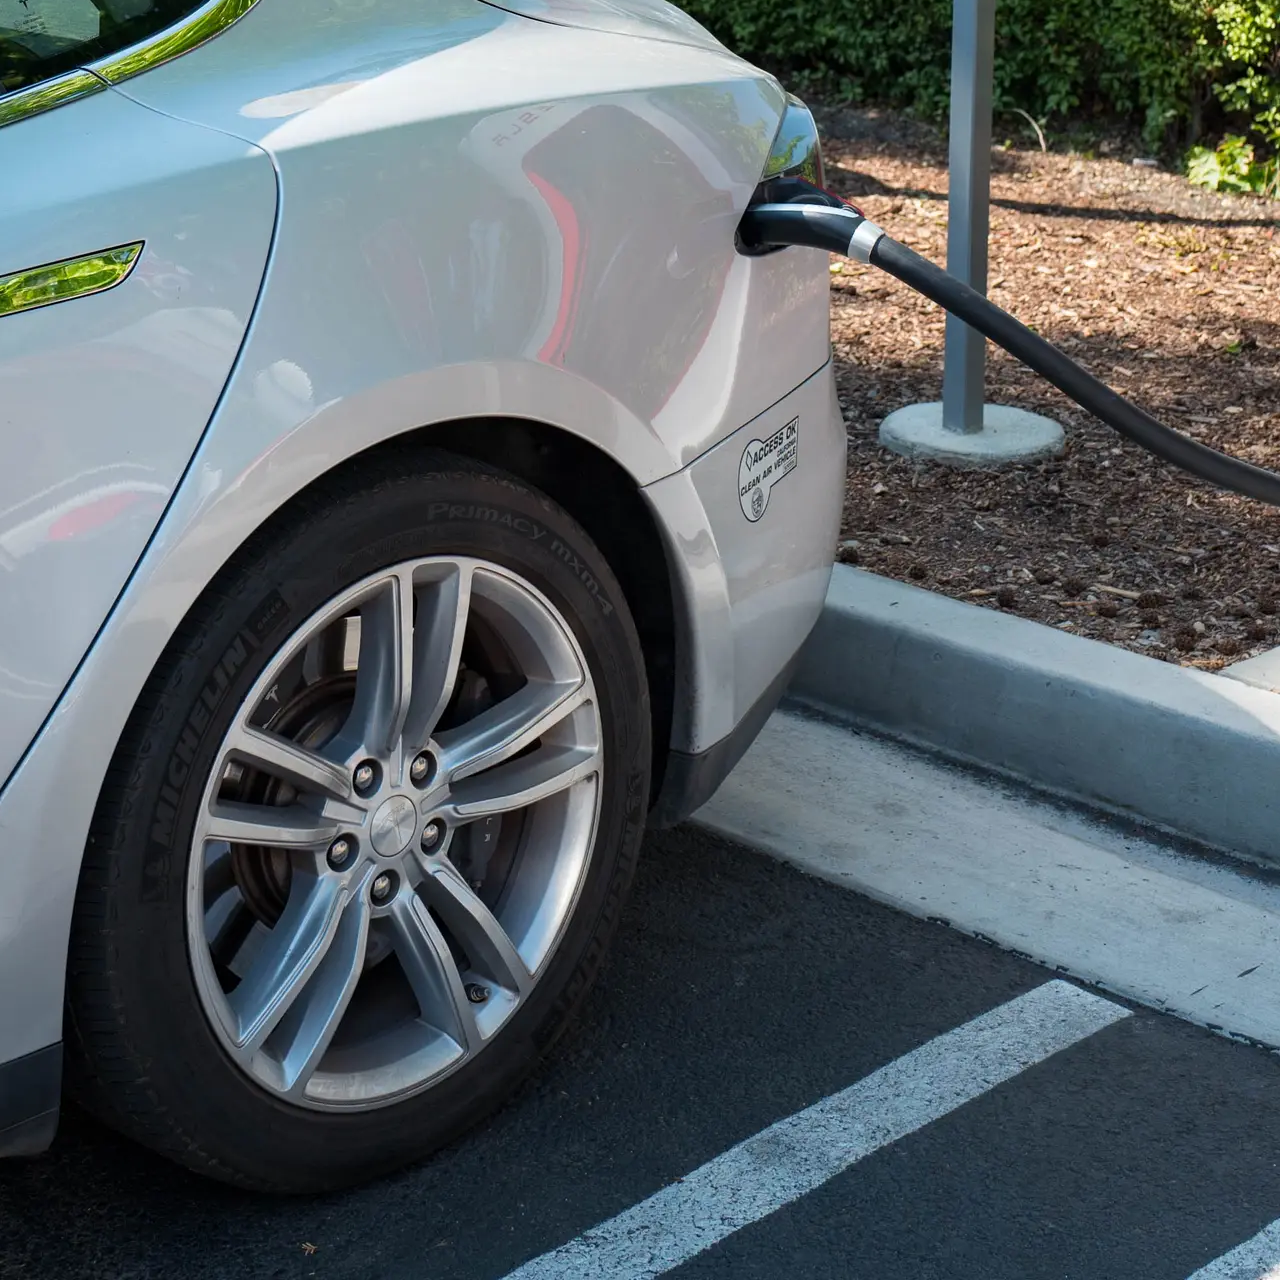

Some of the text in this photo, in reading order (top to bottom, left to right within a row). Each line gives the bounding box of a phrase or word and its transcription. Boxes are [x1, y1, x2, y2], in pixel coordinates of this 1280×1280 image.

[753, 432, 783, 466] ACCESS
[786, 421, 797, 439] OK
[741, 474, 761, 497] CLEAN
[762, 466, 772, 480] AIR
[774, 446, 796, 470] VEHICLE
[150, 633, 250, 847] MICHELIN
